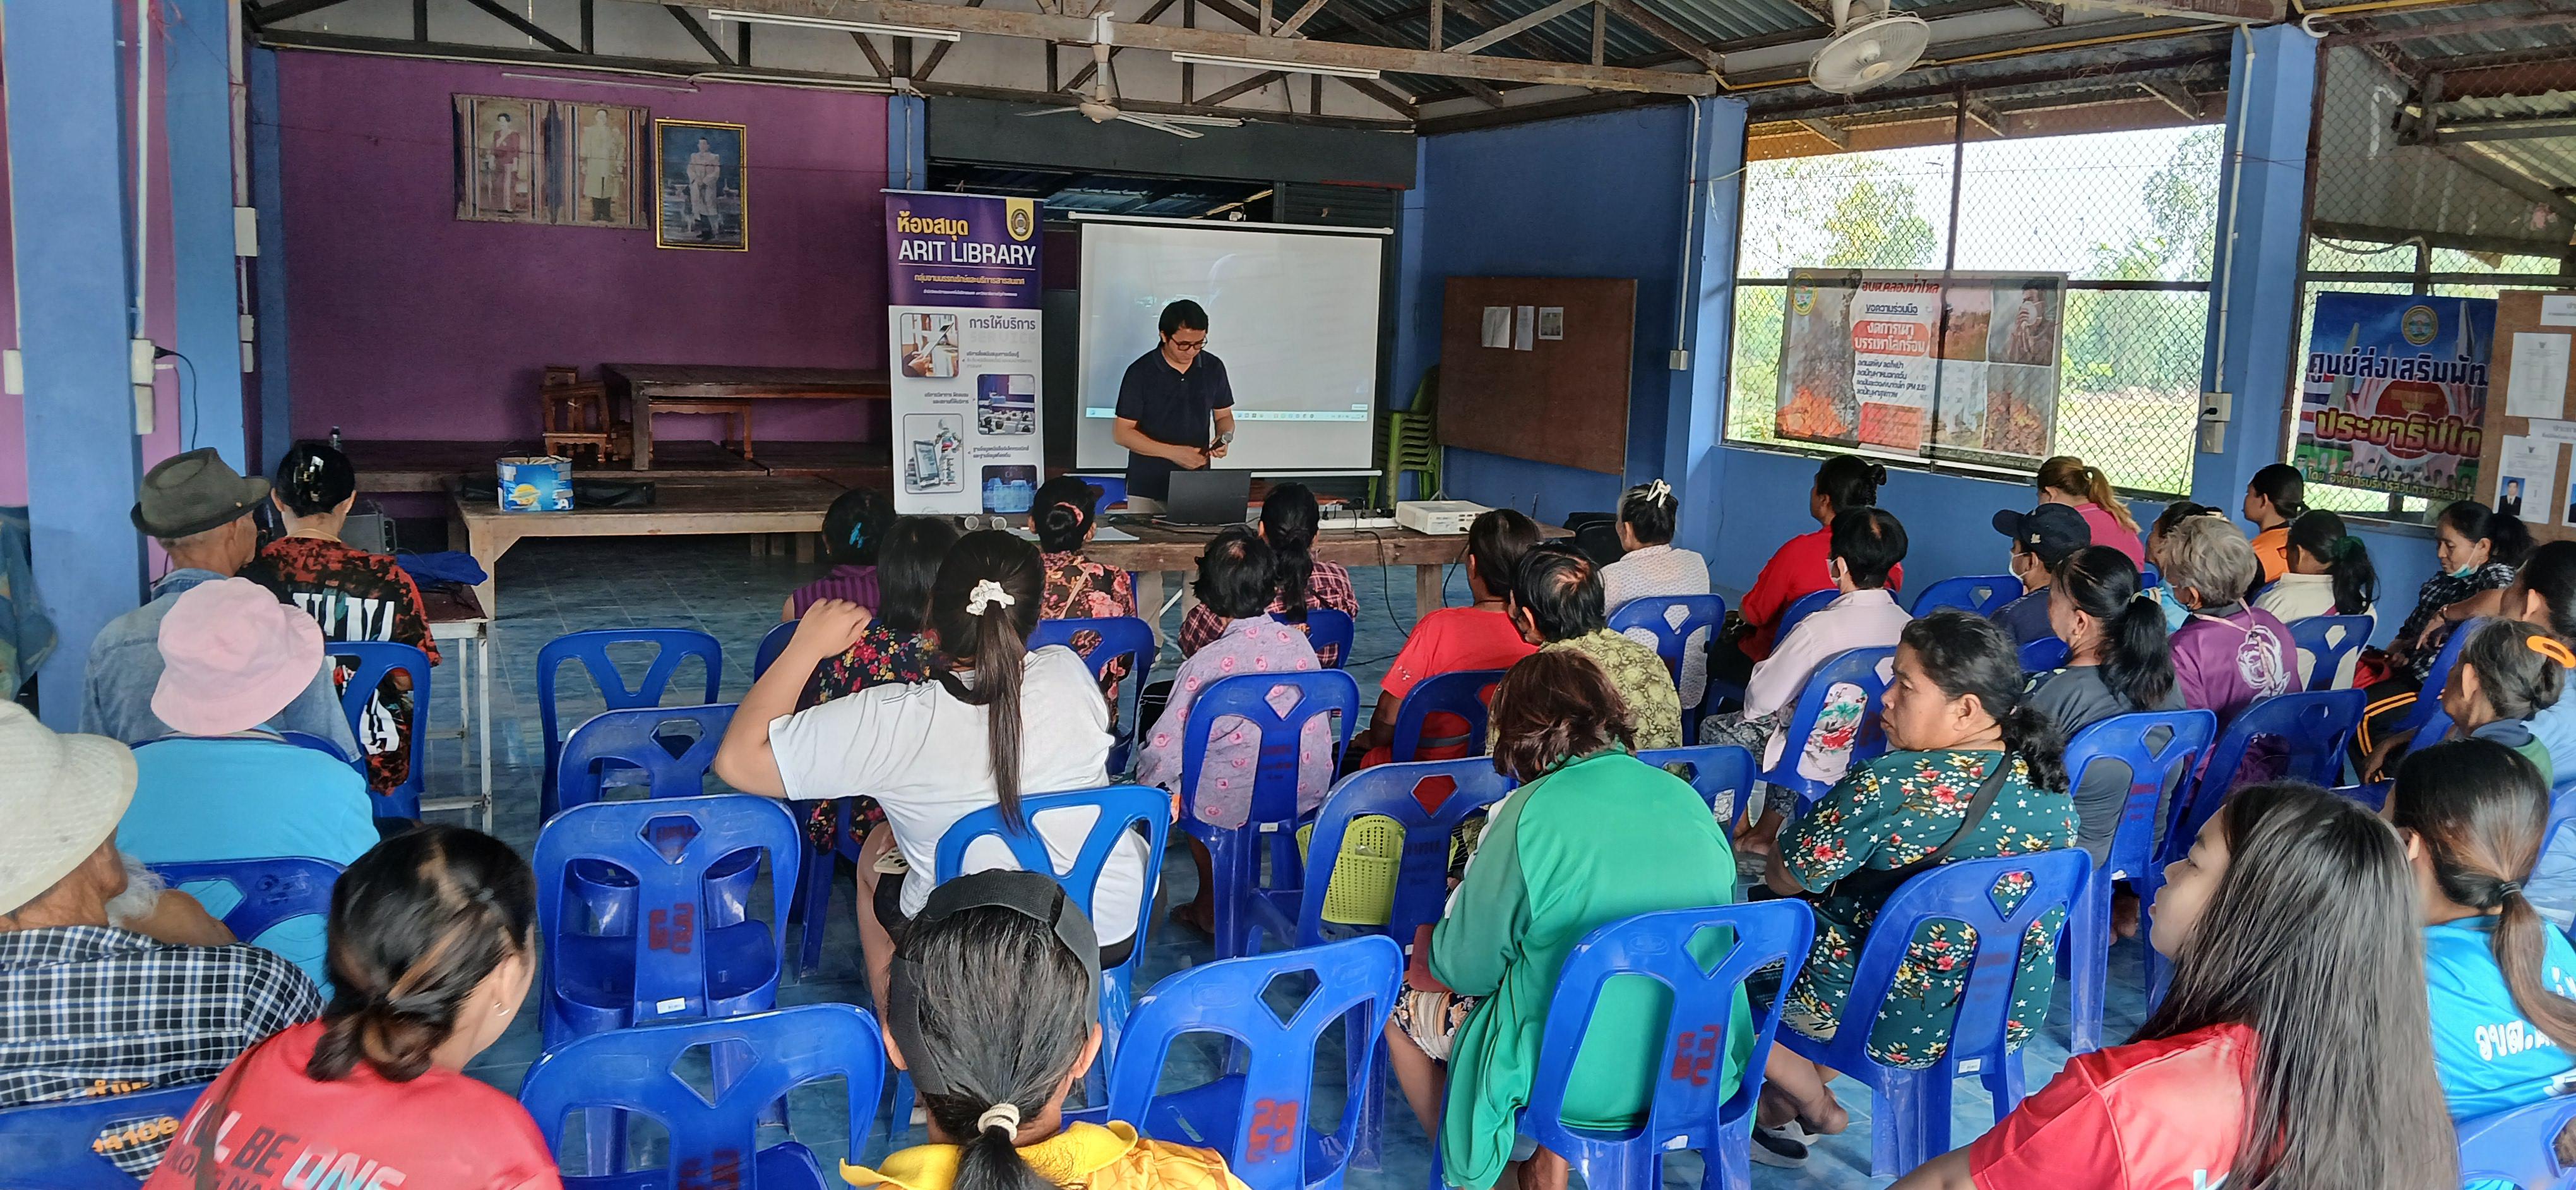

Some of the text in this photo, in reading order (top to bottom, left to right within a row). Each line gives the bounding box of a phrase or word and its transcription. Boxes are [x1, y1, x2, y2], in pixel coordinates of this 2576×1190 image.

[897, 210, 969, 241] ห้องสมุด
[898, 239, 1036, 265] ARIT LIBRARY
[1866, 302, 1918, 313] ขอความร่วมมือ
[969, 315, 1036, 330] การให้บริการ
[2308, 466, 2325, 481] โดย
[231, 1126, 299, 1178] BE
